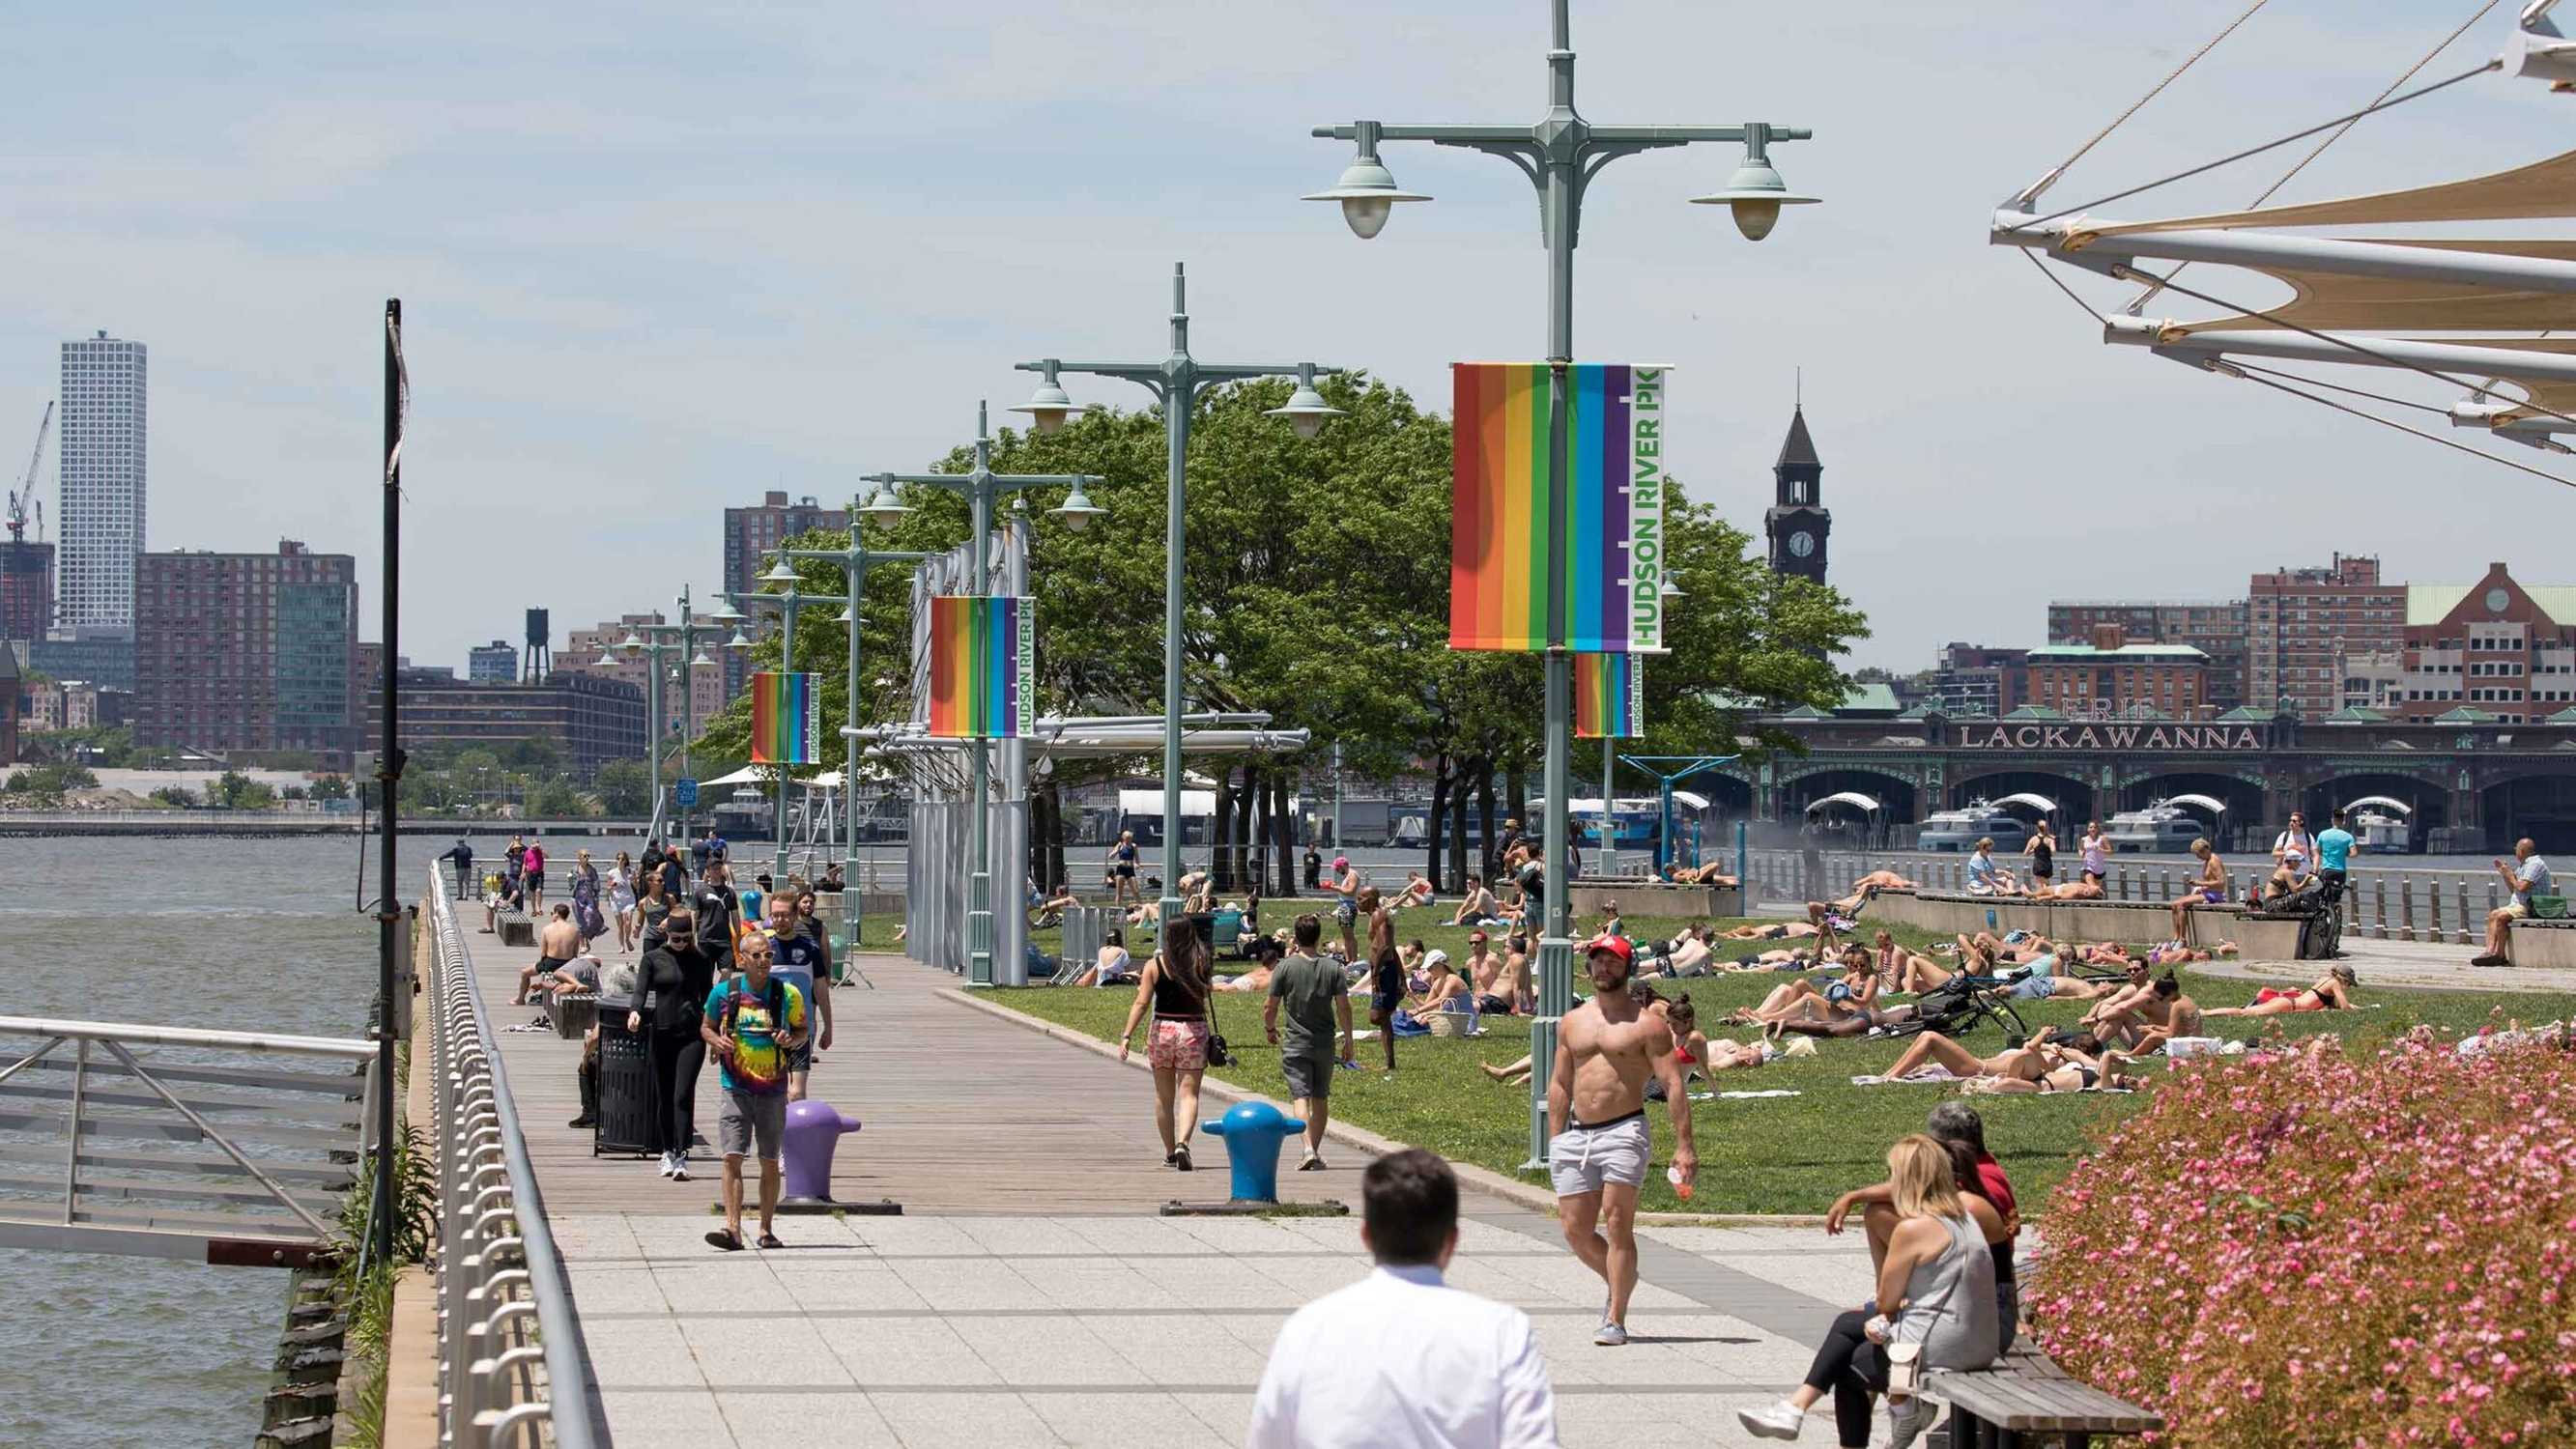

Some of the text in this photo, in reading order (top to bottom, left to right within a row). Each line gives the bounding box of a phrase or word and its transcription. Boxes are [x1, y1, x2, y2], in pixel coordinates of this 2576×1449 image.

[1634, 369, 1660, 645] HUDSON RIVER PK
[1019, 600, 1032, 735] HUDSON RIVER PK
[1633, 663, 1642, 693] RIVER
[811, 691, 819, 720] RIVER
[1633, 695, 1642, 734] HUDSON
[810, 722, 819, 761] HUDSON
[1959, 725, 2261, 749] LACKAWANNA
